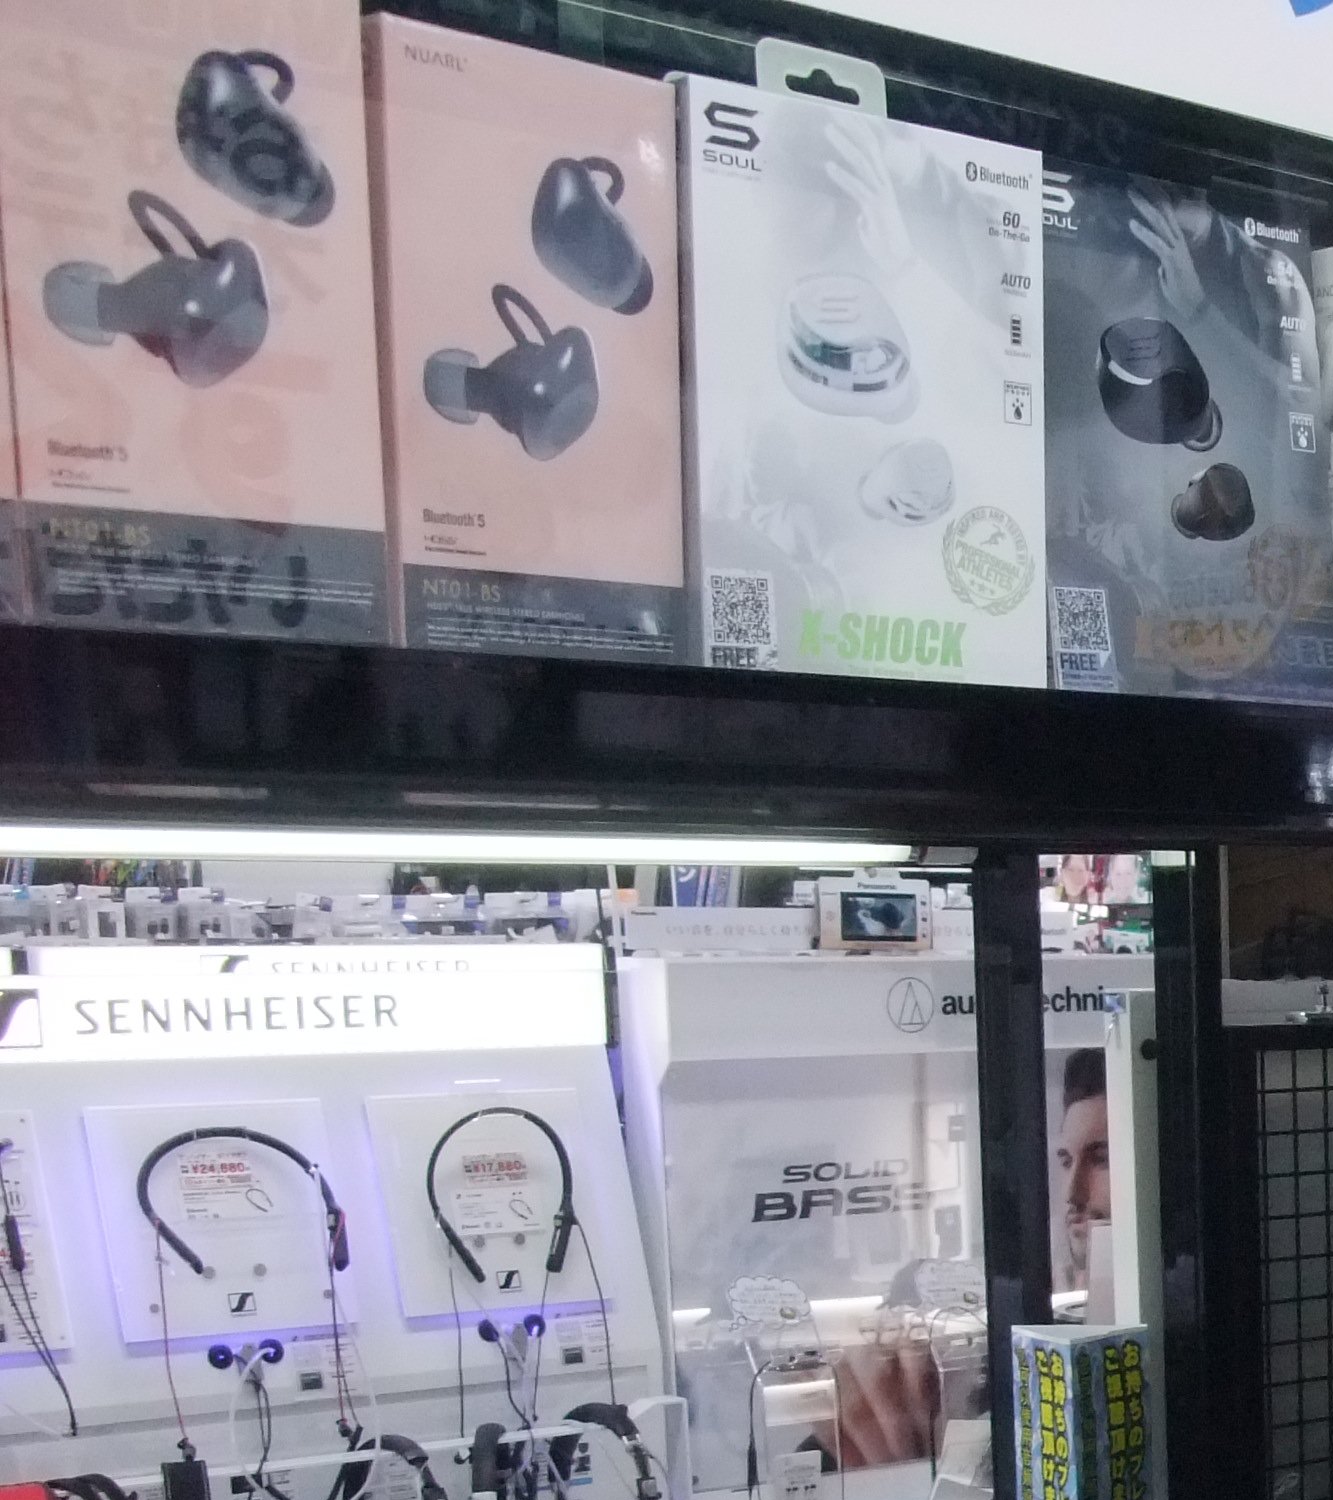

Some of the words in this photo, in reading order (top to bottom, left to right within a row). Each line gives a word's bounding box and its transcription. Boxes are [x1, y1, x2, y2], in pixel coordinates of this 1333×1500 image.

[702, 149, 763, 173] SOUL
[979, 166, 1030, 191] Bluetooth
[1042, 213, 1079, 231] OUL
[1256, 221, 1300, 243] Bluetooth
[1001, 273, 1031, 290] AUTO
[801, 607, 968, 668] X-SHOCK
[713, 647, 758, 668] FREE
[1059, 653, 1099, 672] FREE
[74, 993, 400, 1037] SENNHEISER
[782, 1159, 909, 1184] SOLID
